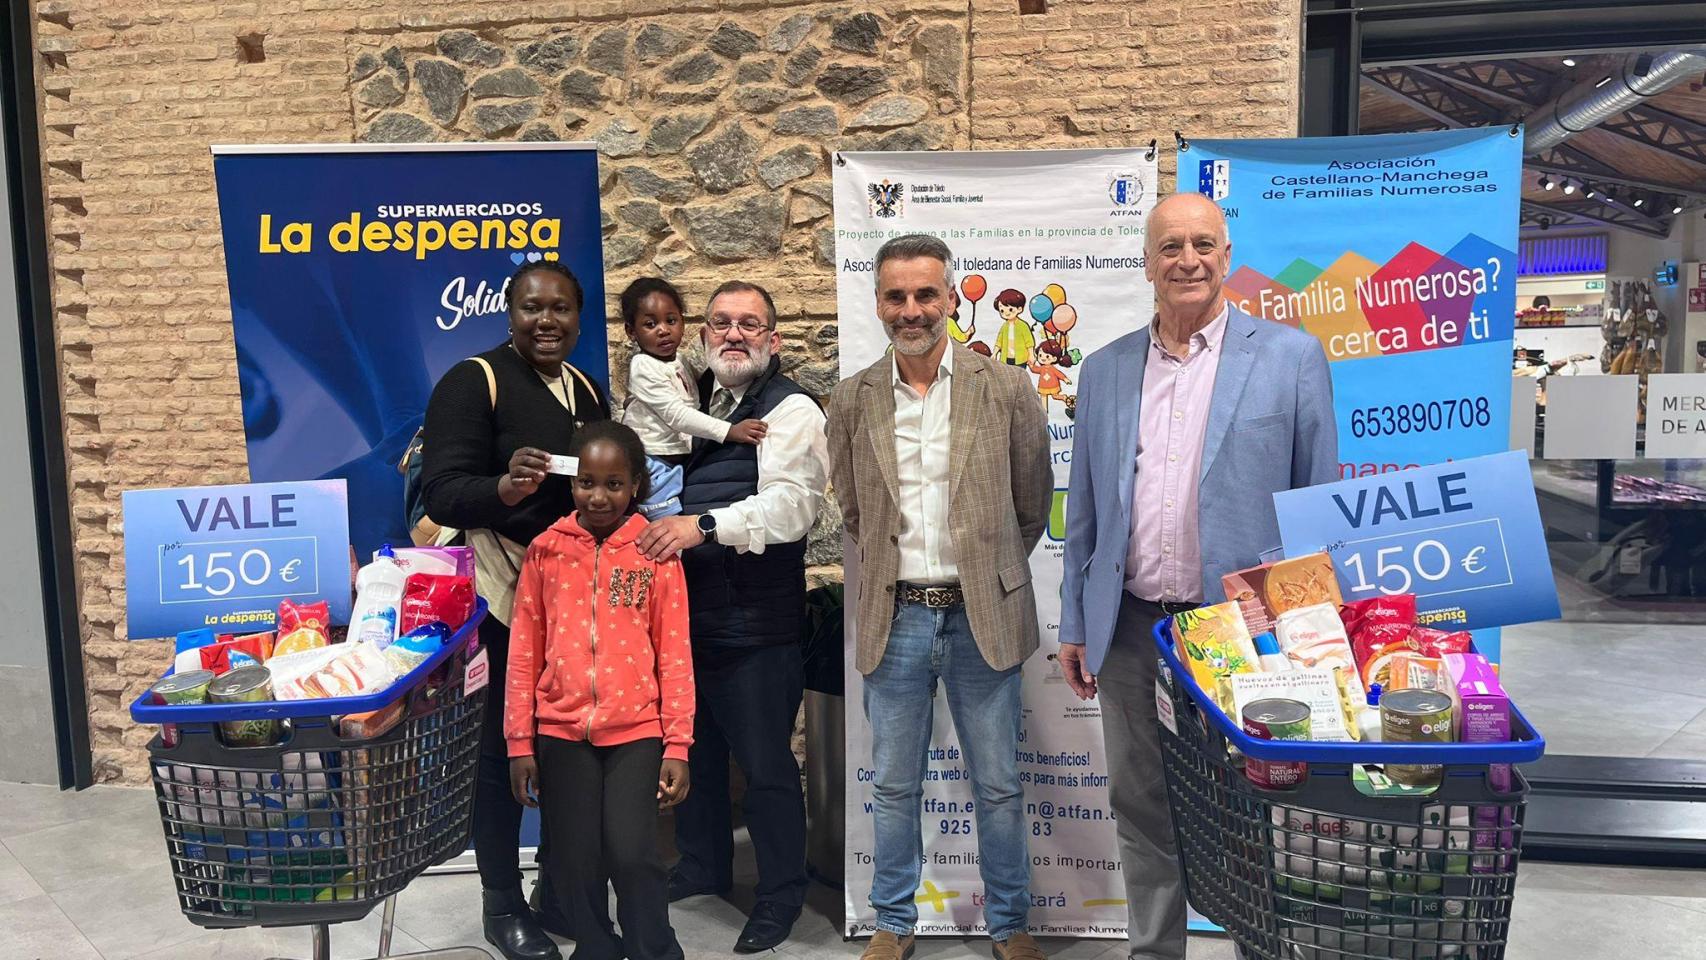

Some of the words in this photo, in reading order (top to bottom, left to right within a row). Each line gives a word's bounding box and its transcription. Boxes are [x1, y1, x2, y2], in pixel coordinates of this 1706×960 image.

[1327, 157, 1436, 171] Asociación
[1271, 169, 1489, 186] Castellano-Manchega
[1262, 187, 1286, 200] de
[1293, 186, 1374, 199] Familias
[1381, 183, 1498, 197] Numerosas
[377, 202, 543, 218] SUPERMERCADOS
[259, 214, 313, 254] La
[328, 211, 561, 260] despensa
[838, 228, 884, 243] Proyecto
[888, 228, 900, 238] de
[941, 230, 946, 238] a
[950, 228, 966, 238] las
[969, 227, 1014, 238] Familias
[1018, 228, 1031, 237] en
[1035, 227, 1044, 237] la
[1048, 226, 1096, 239] provincia
[1100, 226, 1113, 236] de
[963, 256, 1013, 271] toledana
[1016, 256, 1031, 270] de
[1034, 255, 1082, 270] Familias
[1259, 280, 1346, 320] Familia
[1354, 257, 1501, 310] Numerosa?
[1329, 326, 1408, 357] cerca
[1420, 315, 1458, 346] de
[1468, 309, 1489, 340] ti
[1350, 396, 1491, 438] 653890708
[1661, 419, 1688, 434] DE
[1331, 471, 1474, 529] VALE
[176, 493, 298, 532] VALE
[178, 549, 273, 596] 150
[279, 558, 302, 583] €
[1343, 539, 1451, 596] 150
[1461, 545, 1487, 574] €
[204, 613, 218, 625] La
[221, 611, 276, 625] despensa
[947, 745, 959, 760] de
[1036, 750, 1090, 767] beneficios!
[940, 766, 960, 781] web
[1033, 772, 1055, 787] para
[1057, 773, 1079, 787] más
[1269, 768, 1301, 776] NATURAL
[940, 819, 971, 835] 925
[1032, 821, 1052, 837] 83
[1424, 901, 1438, 911] x6
[920, 924, 972, 933] provincial
[1040, 924, 1086, 933] Familias
